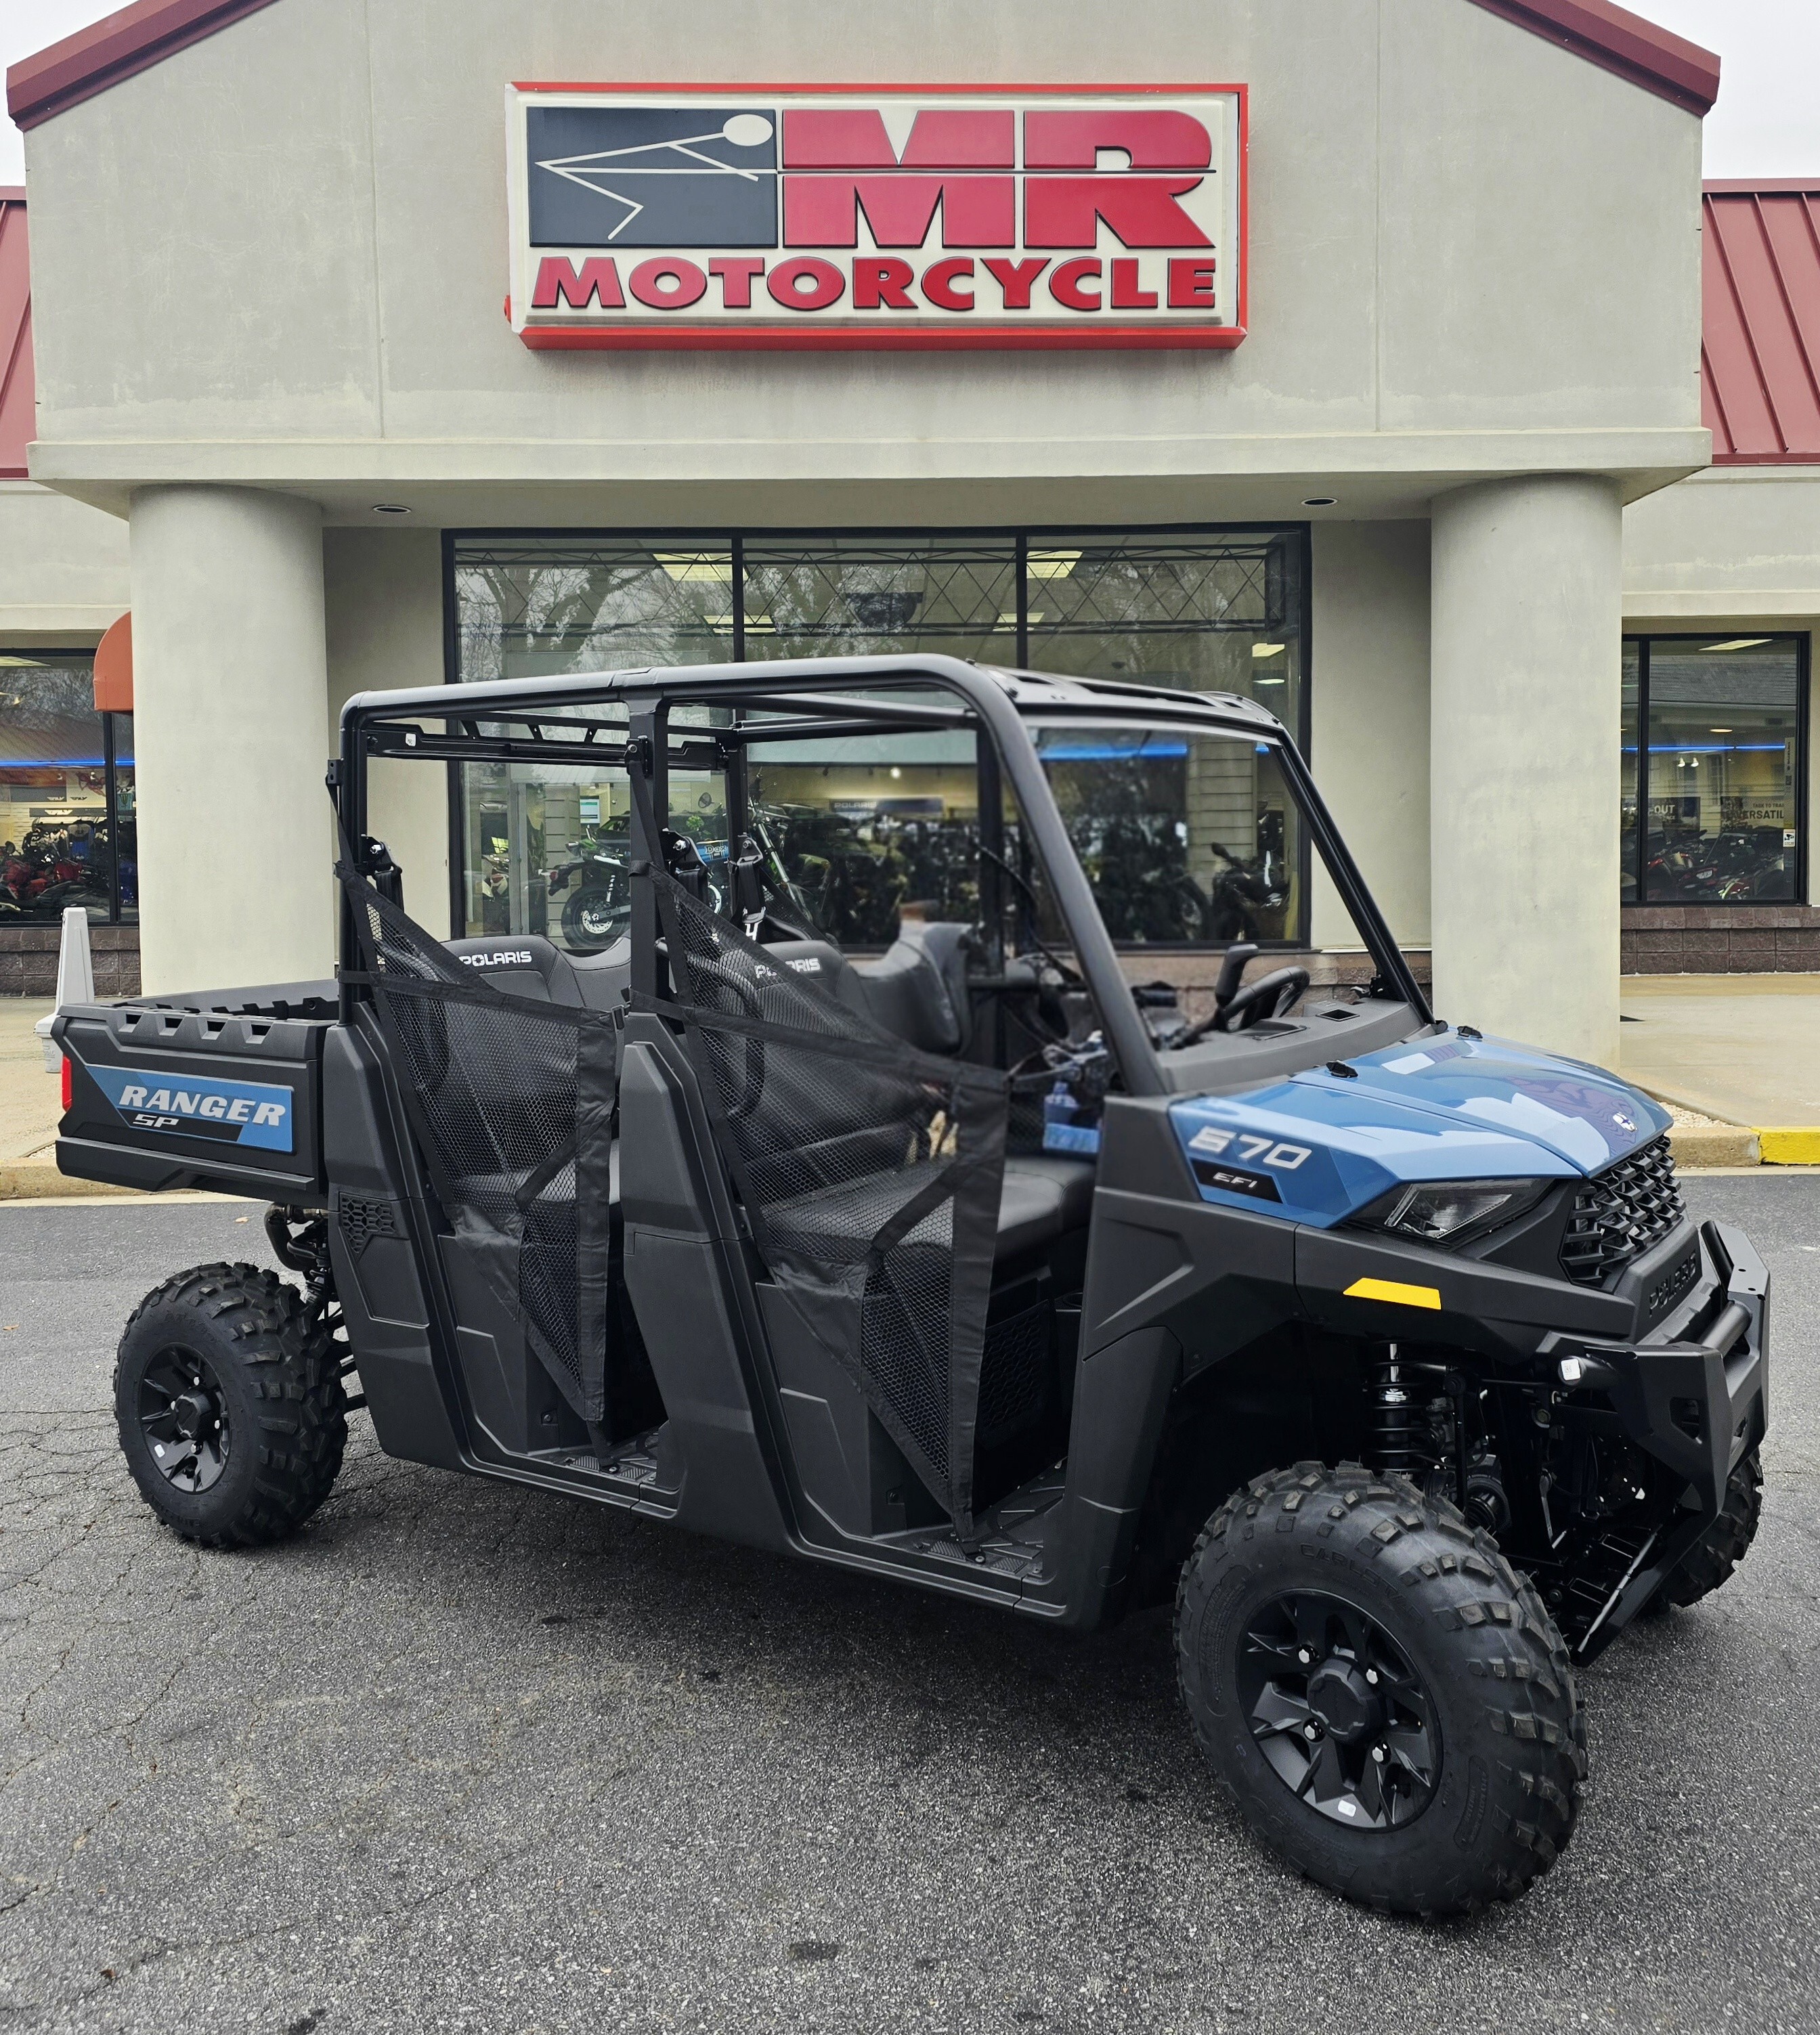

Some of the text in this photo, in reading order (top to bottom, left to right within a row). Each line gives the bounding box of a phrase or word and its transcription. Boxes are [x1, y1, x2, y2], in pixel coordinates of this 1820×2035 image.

[782, 109, 1217, 249] MR
[531, 255, 1217, 311] MOTORCYCLE
[705, 845, 727, 854] Dax
[458, 950, 532, 967] POLARIS
[118, 1085, 286, 1126] RANGER
[133, 1114, 179, 1129] SP
[1188, 1125, 1313, 1170] 570
[1213, 1171, 1258, 1188] EFI
[1648, 1248, 1697, 1319] POLARIS
